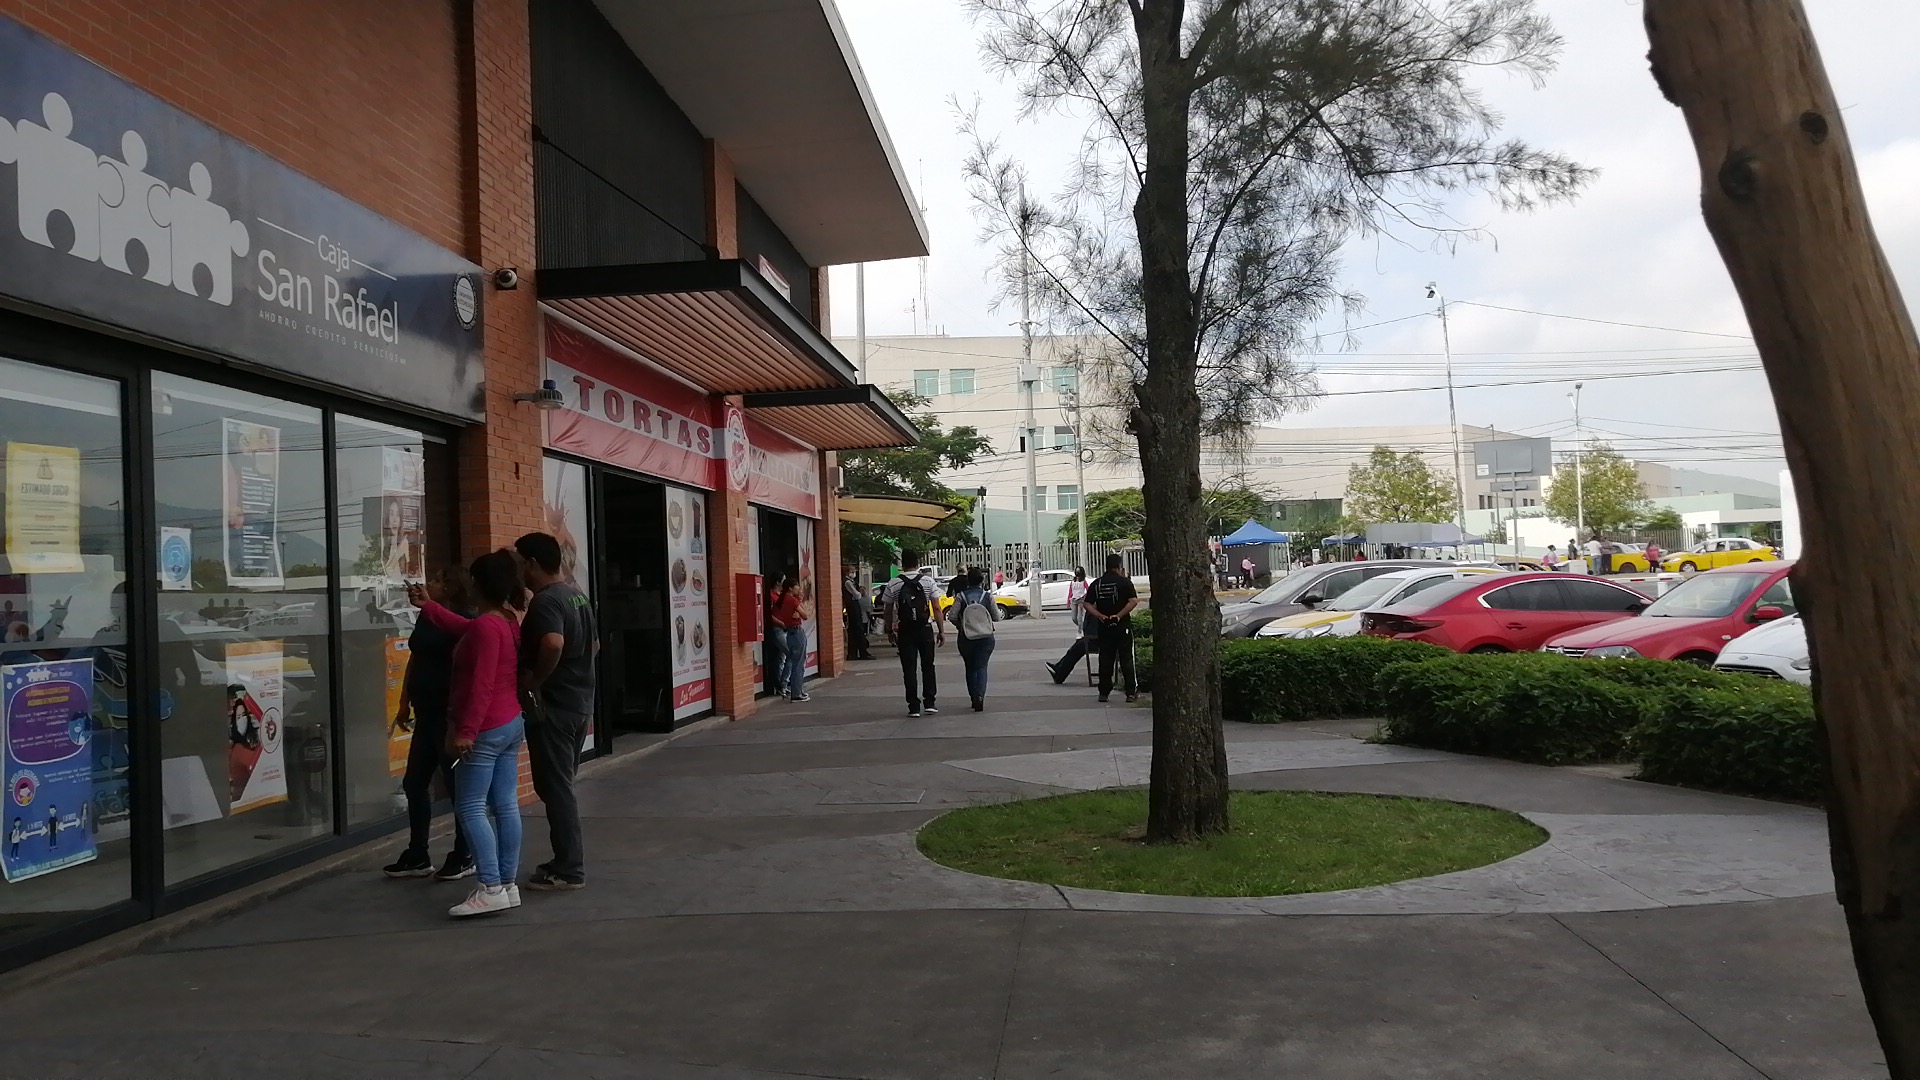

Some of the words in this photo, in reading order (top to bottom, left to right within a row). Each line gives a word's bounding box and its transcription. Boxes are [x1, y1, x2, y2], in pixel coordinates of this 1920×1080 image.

[318, 234, 350, 273] Caja
[257, 249, 313, 315] San
[324, 274, 399, 345] Rafael
[258, 309, 298, 330] AHORRO
[573, 375, 711, 454] TORTAS
[21, 482, 51, 496] ESTIMADO
